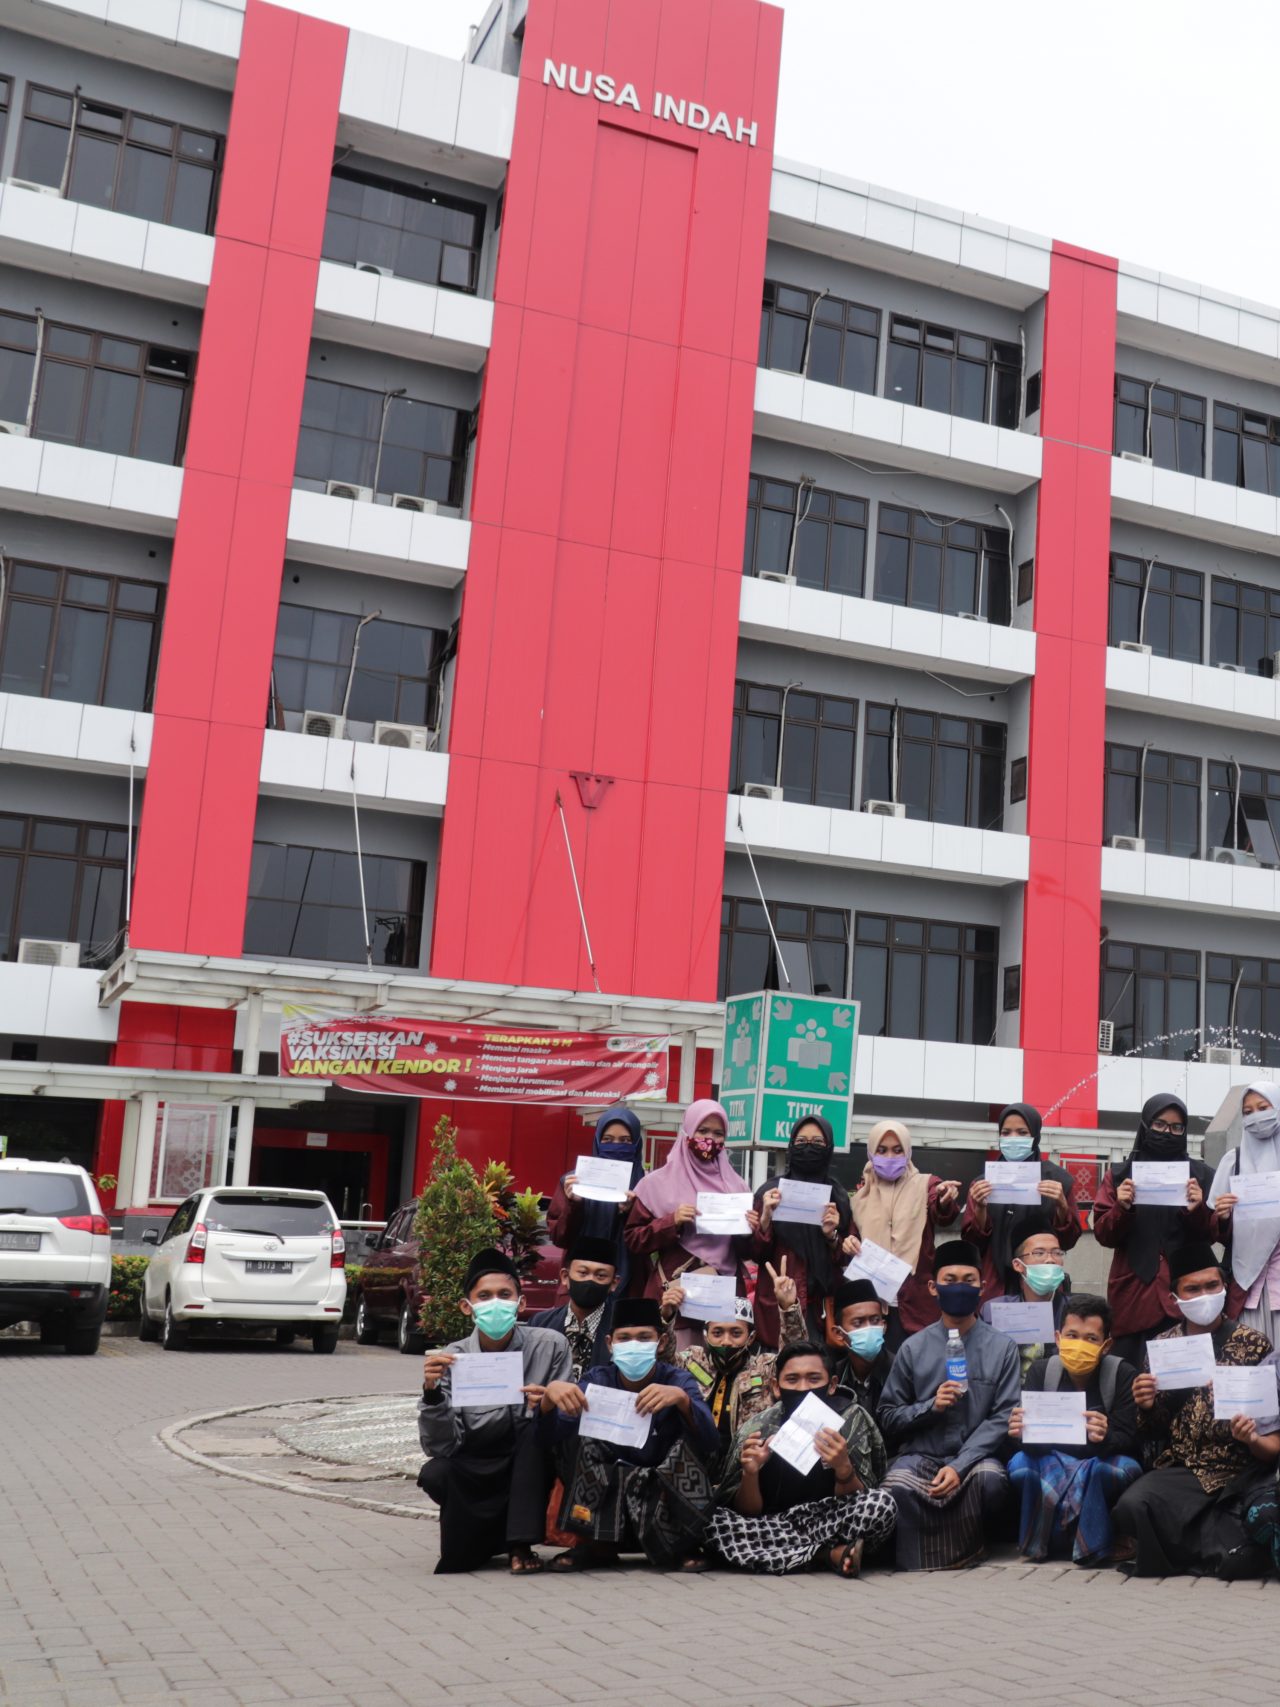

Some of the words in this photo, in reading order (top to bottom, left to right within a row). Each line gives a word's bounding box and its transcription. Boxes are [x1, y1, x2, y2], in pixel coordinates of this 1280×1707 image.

[543, 58, 640, 112] NUSA
[653, 92, 758, 146] INDAH
[286, 1031, 424, 1047] #SUKSESKAN
[484, 1033, 550, 1046] TERAPKAN
[562, 1039, 573, 1047] M
[288, 1044, 398, 1060] VAKSINASI
[482, 1043, 520, 1053] Memakai
[289, 1060, 374, 1075] JANGAN
[376, 1058, 461, 1074] KENDOR
[464, 1058, 472, 1072] !
[481, 1064, 516, 1073] Menjaga
[479, 1085, 525, 1094] Membatasi
[730, 1101, 745, 1117] TITIK
[787, 1101, 824, 1118] TITIK
